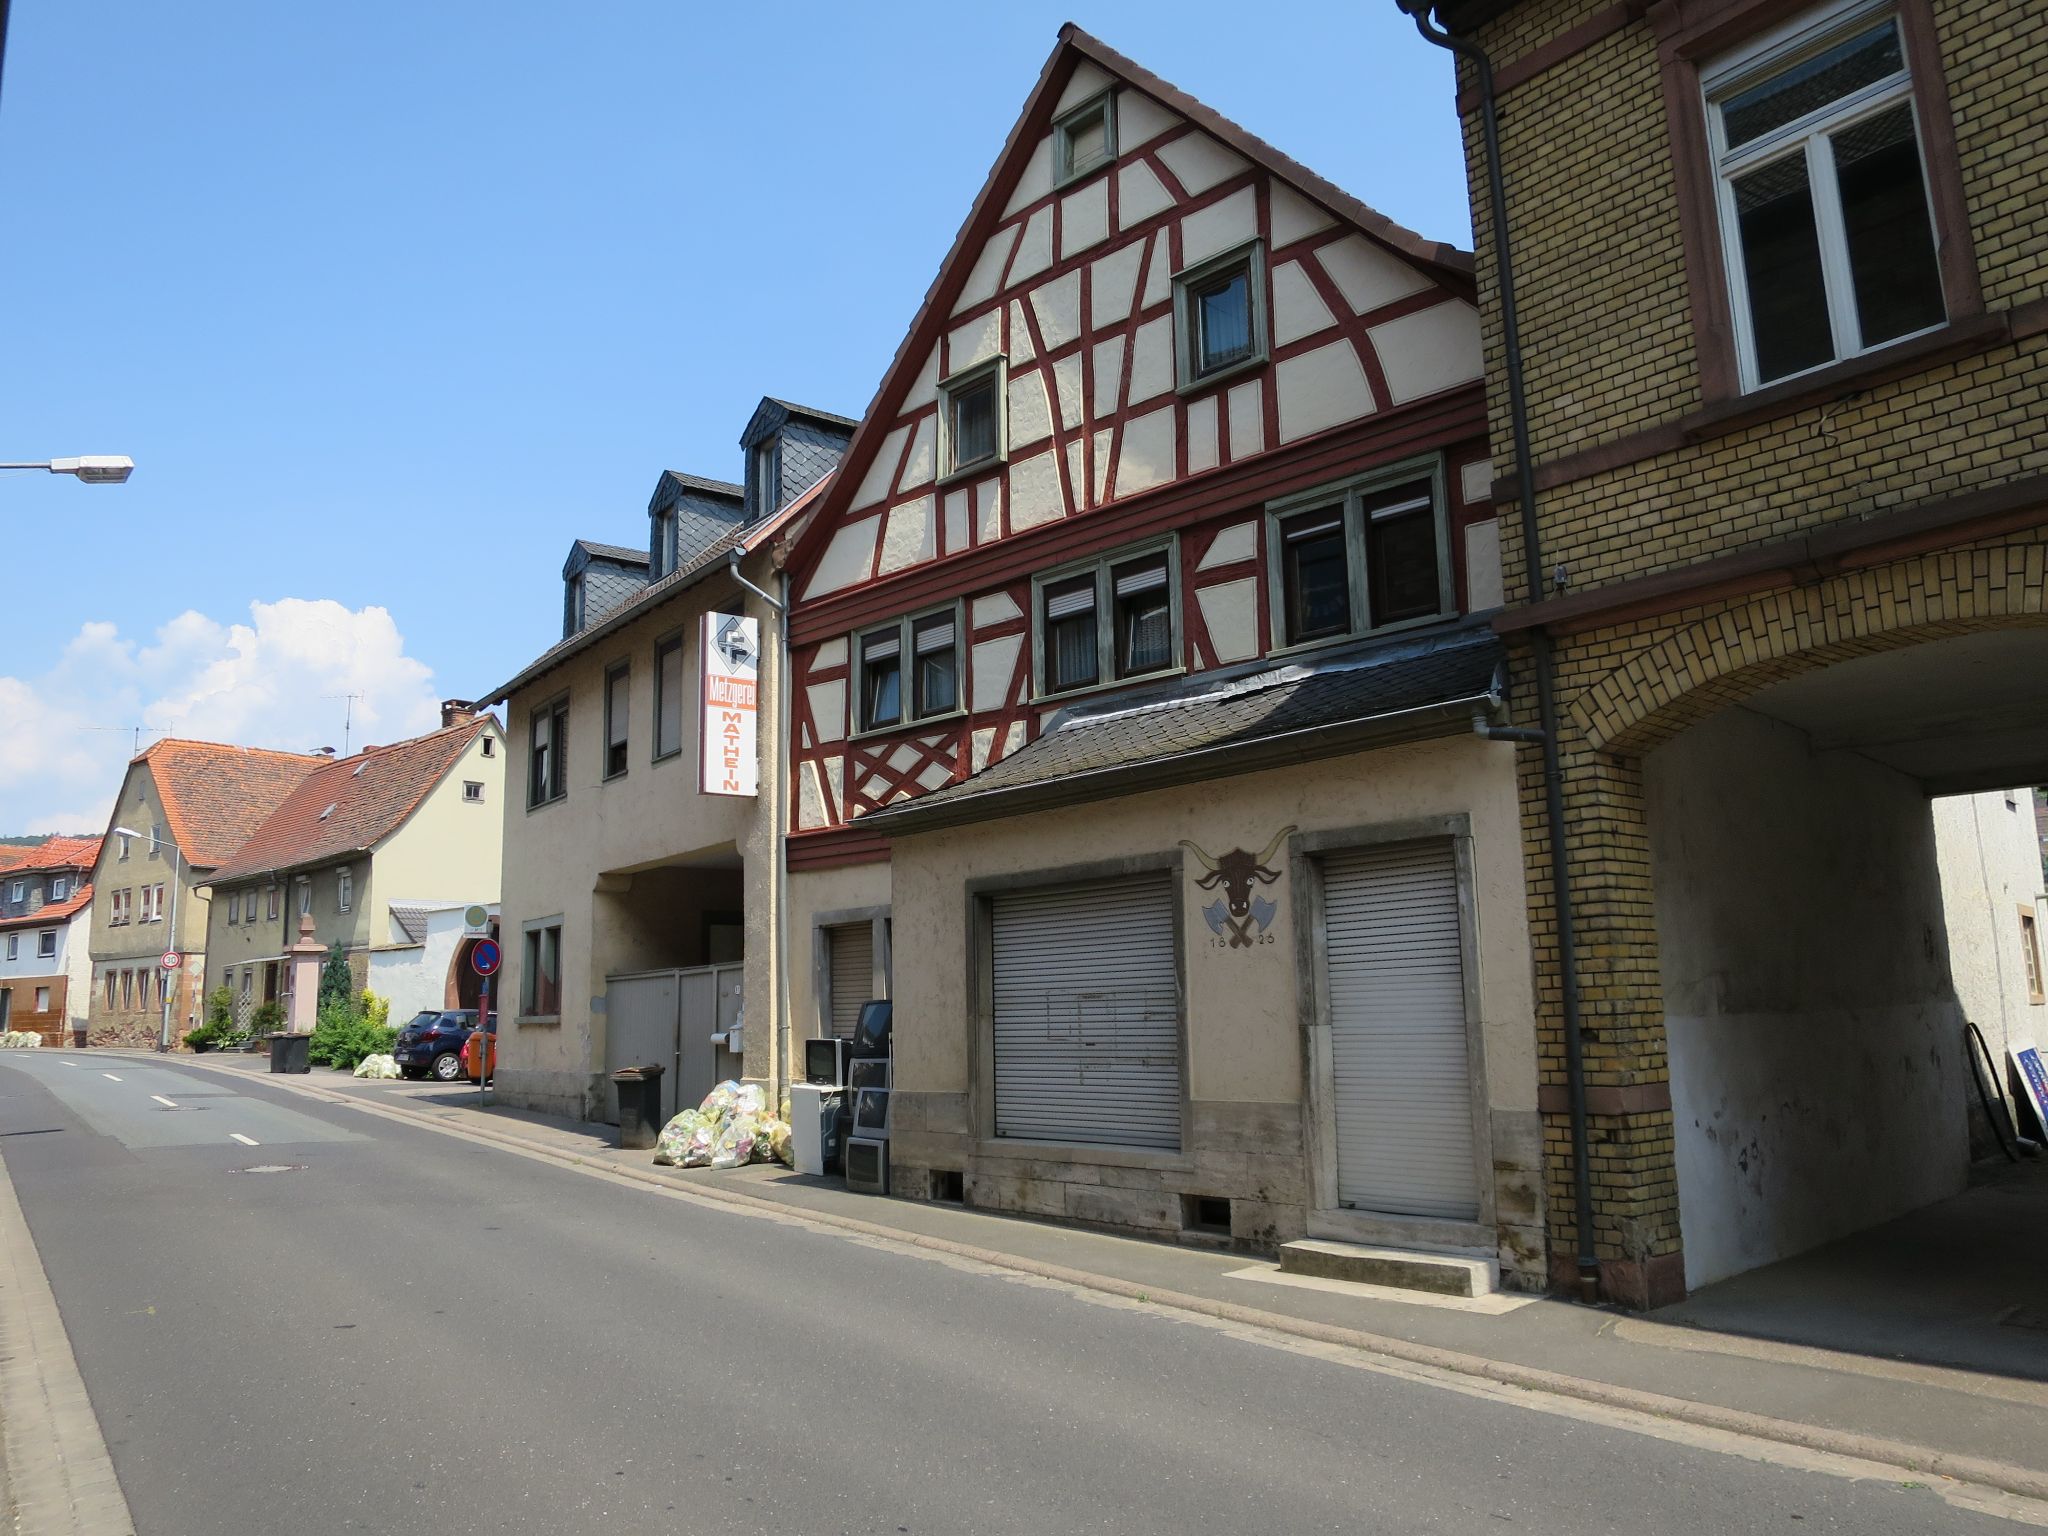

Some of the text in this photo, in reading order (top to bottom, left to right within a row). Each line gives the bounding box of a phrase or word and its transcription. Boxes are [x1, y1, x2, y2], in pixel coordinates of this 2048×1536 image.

[709, 676, 755, 708] Metzgerei
[722, 711, 742, 791] MATHEIN
[166, 956, 176, 965] 30
